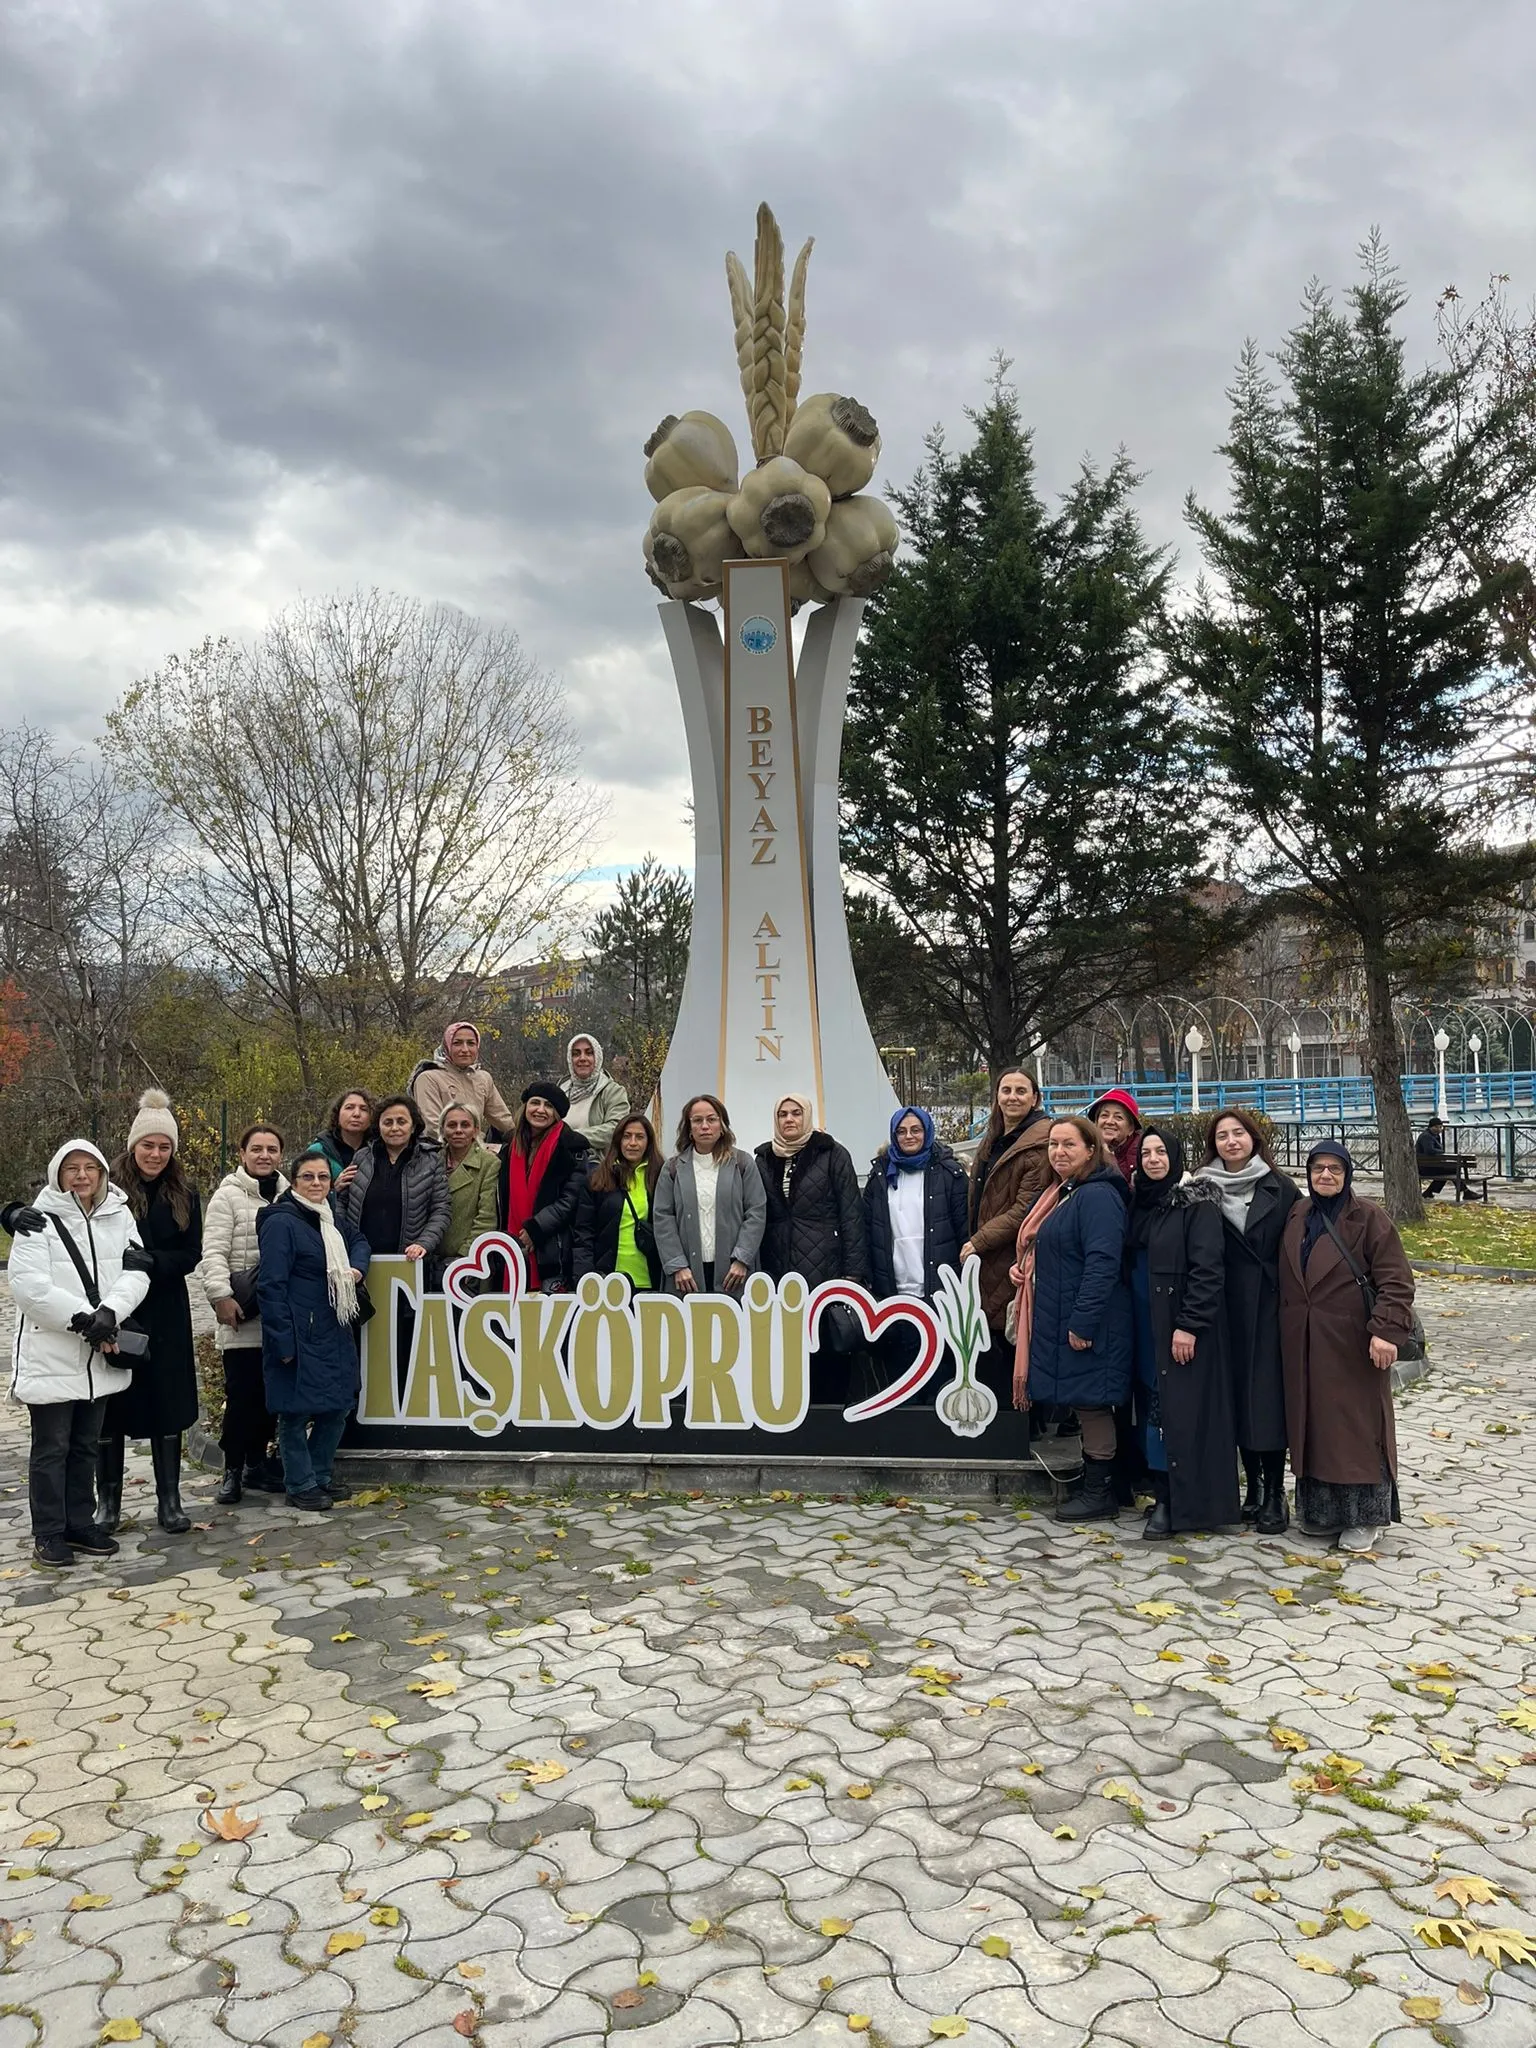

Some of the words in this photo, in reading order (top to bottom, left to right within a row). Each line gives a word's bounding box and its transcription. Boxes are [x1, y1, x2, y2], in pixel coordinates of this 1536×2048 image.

[746, 706, 778, 865] BEYAZ
[753, 911, 784, 1062] ALTIN
[358, 1256, 810, 1436] TAŞKÖPRÜ
